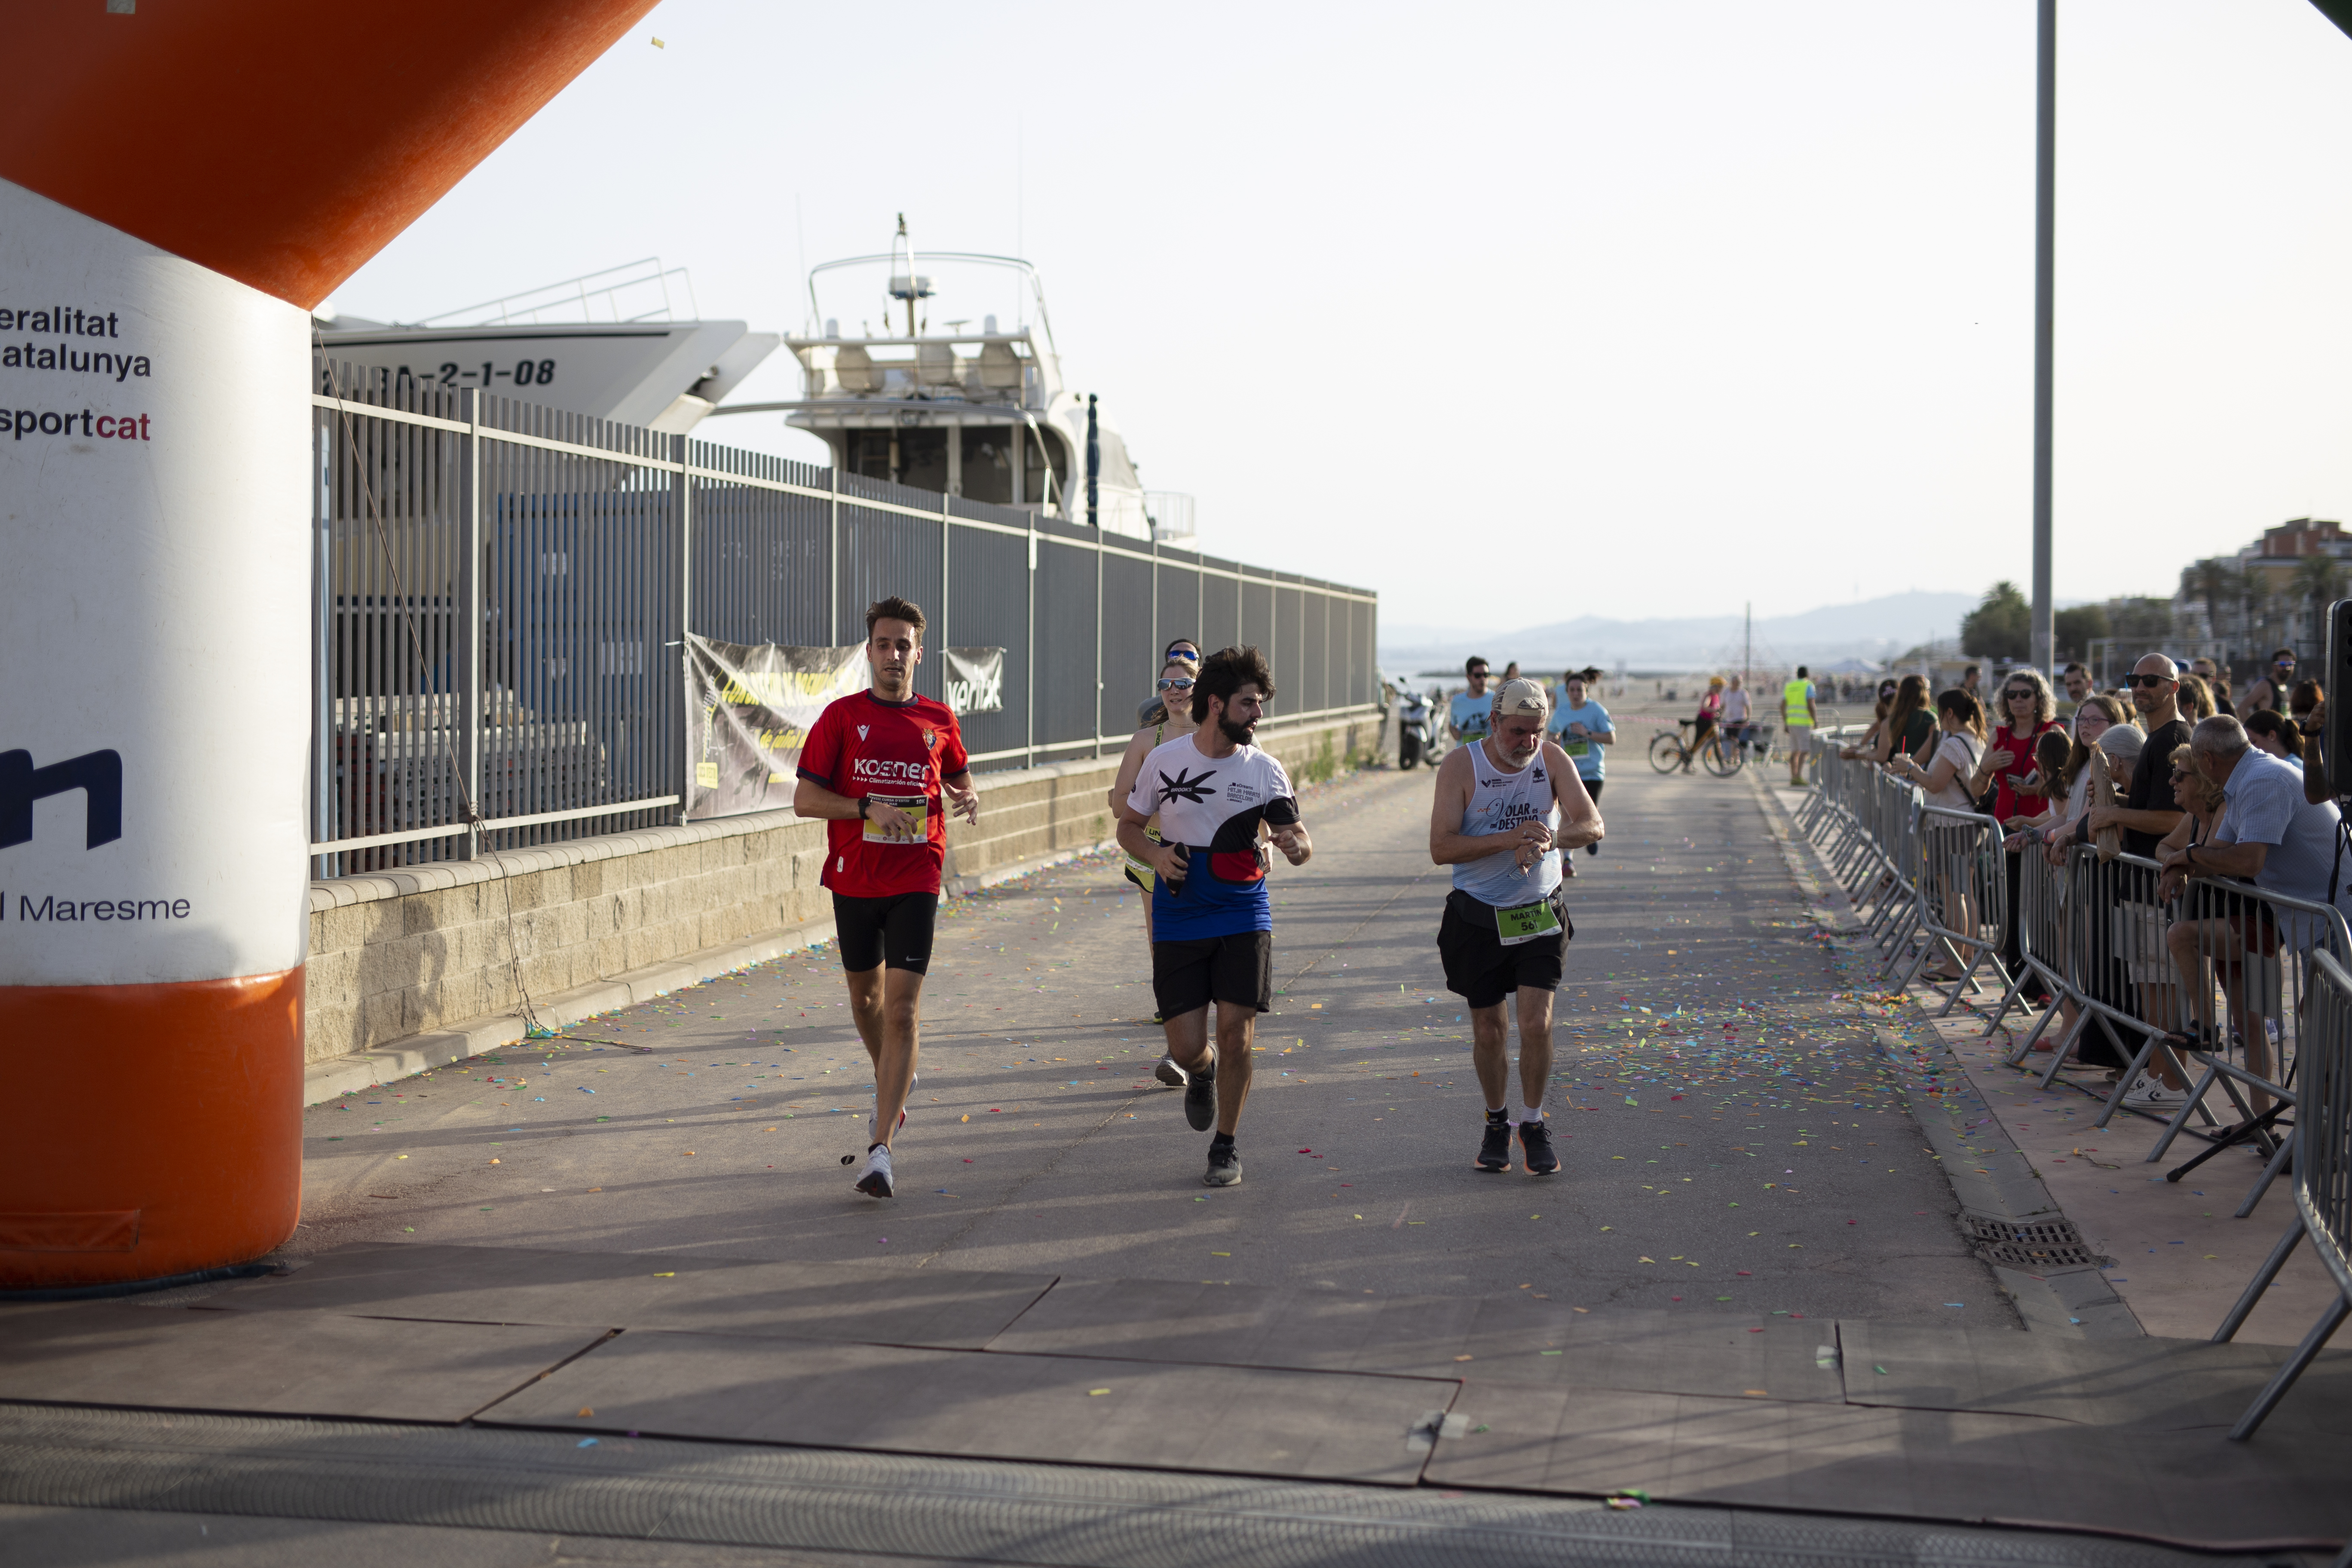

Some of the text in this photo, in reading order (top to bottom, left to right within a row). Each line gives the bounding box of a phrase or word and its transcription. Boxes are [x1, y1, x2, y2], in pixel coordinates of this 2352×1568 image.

[769, 729, 801, 754] juliol
[869, 777, 906, 785] Climatización
[1227, 792, 1253, 802] BARCELONA
[20, 895, 190, 921] Maresme
[1510, 908, 1542, 921] MARTÍN
[1521, 920, 1538, 931] 561
